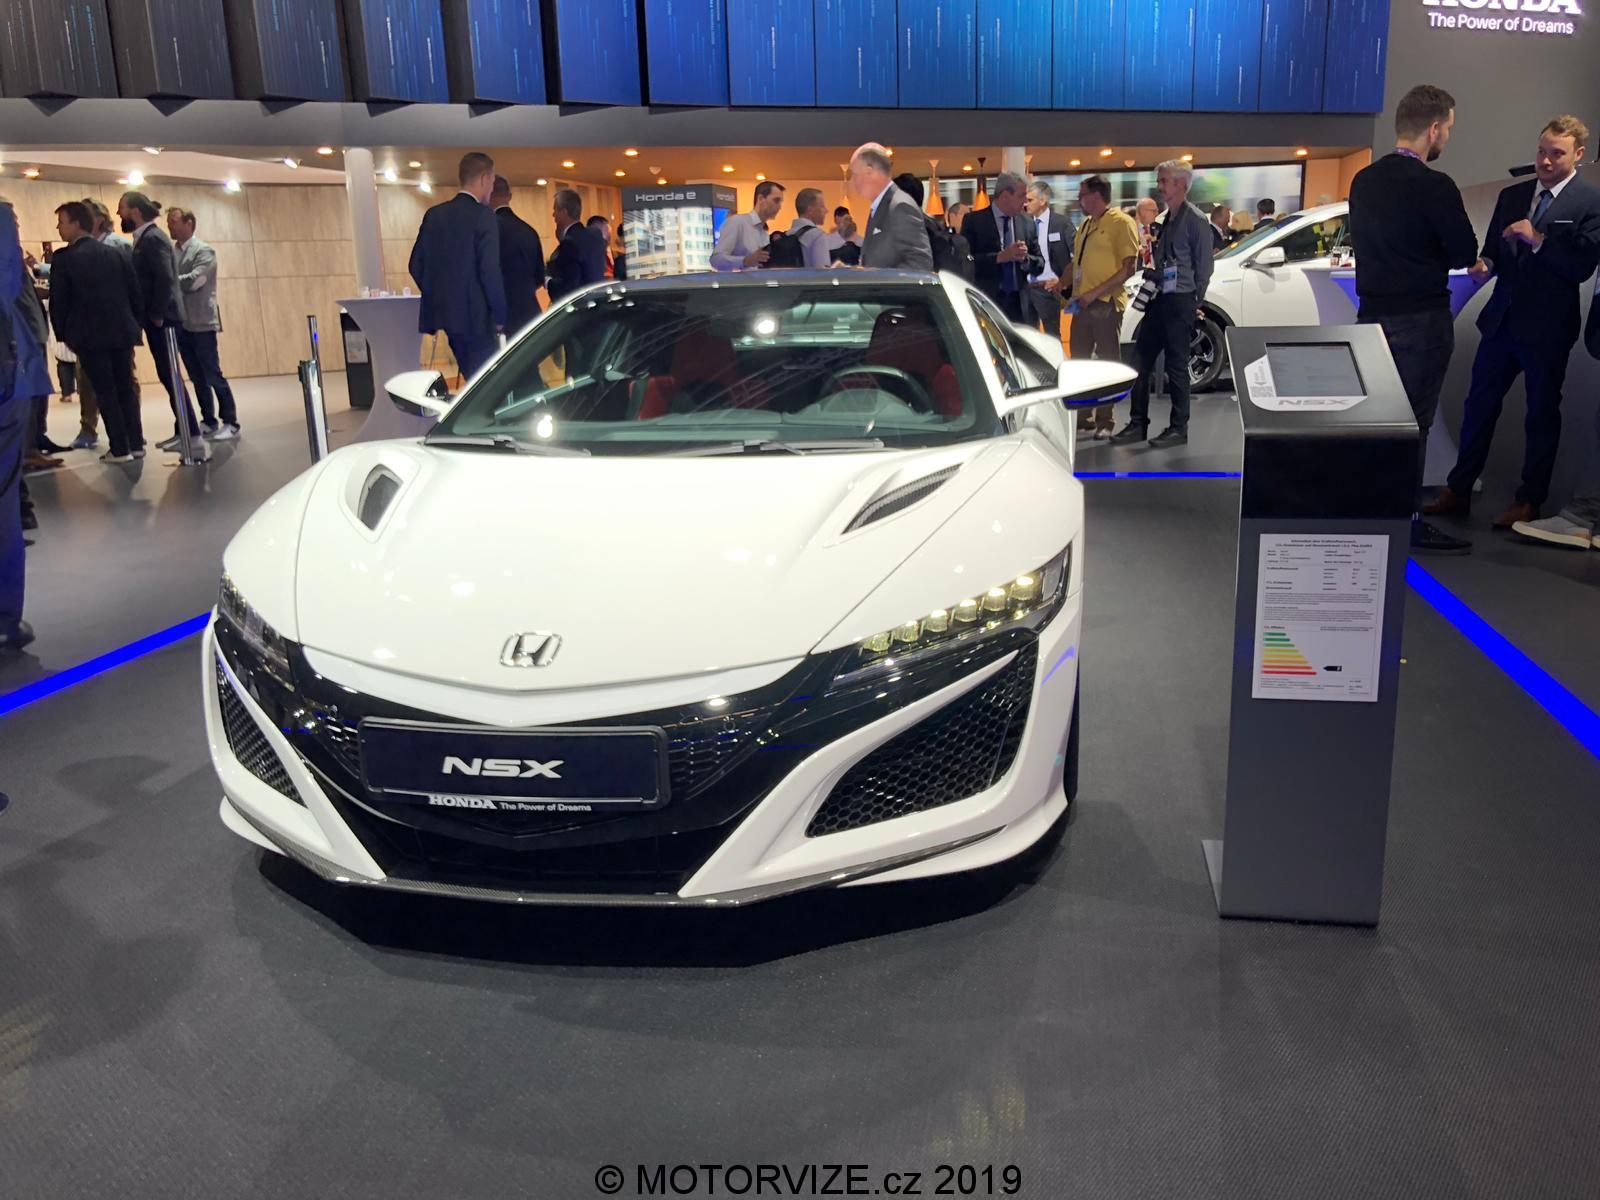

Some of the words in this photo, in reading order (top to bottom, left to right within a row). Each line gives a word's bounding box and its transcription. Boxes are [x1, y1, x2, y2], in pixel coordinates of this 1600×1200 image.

[1428, 12, 1456, 27] The
[1457, 14, 1501, 30] Power
[1504, 17, 1520, 31] of
[1522, 18, 1574, 34] Dreams
[635, 193, 685, 202] Honda
[686, 191, 697, 200] e
[441, 756, 564, 779] NSX
[428, 795, 498, 810] HONDA
[500, 802, 516, 810] The
[518, 803, 545, 811] Power
[547, 803, 557, 811] of
[558, 804, 592, 812] Dreams
